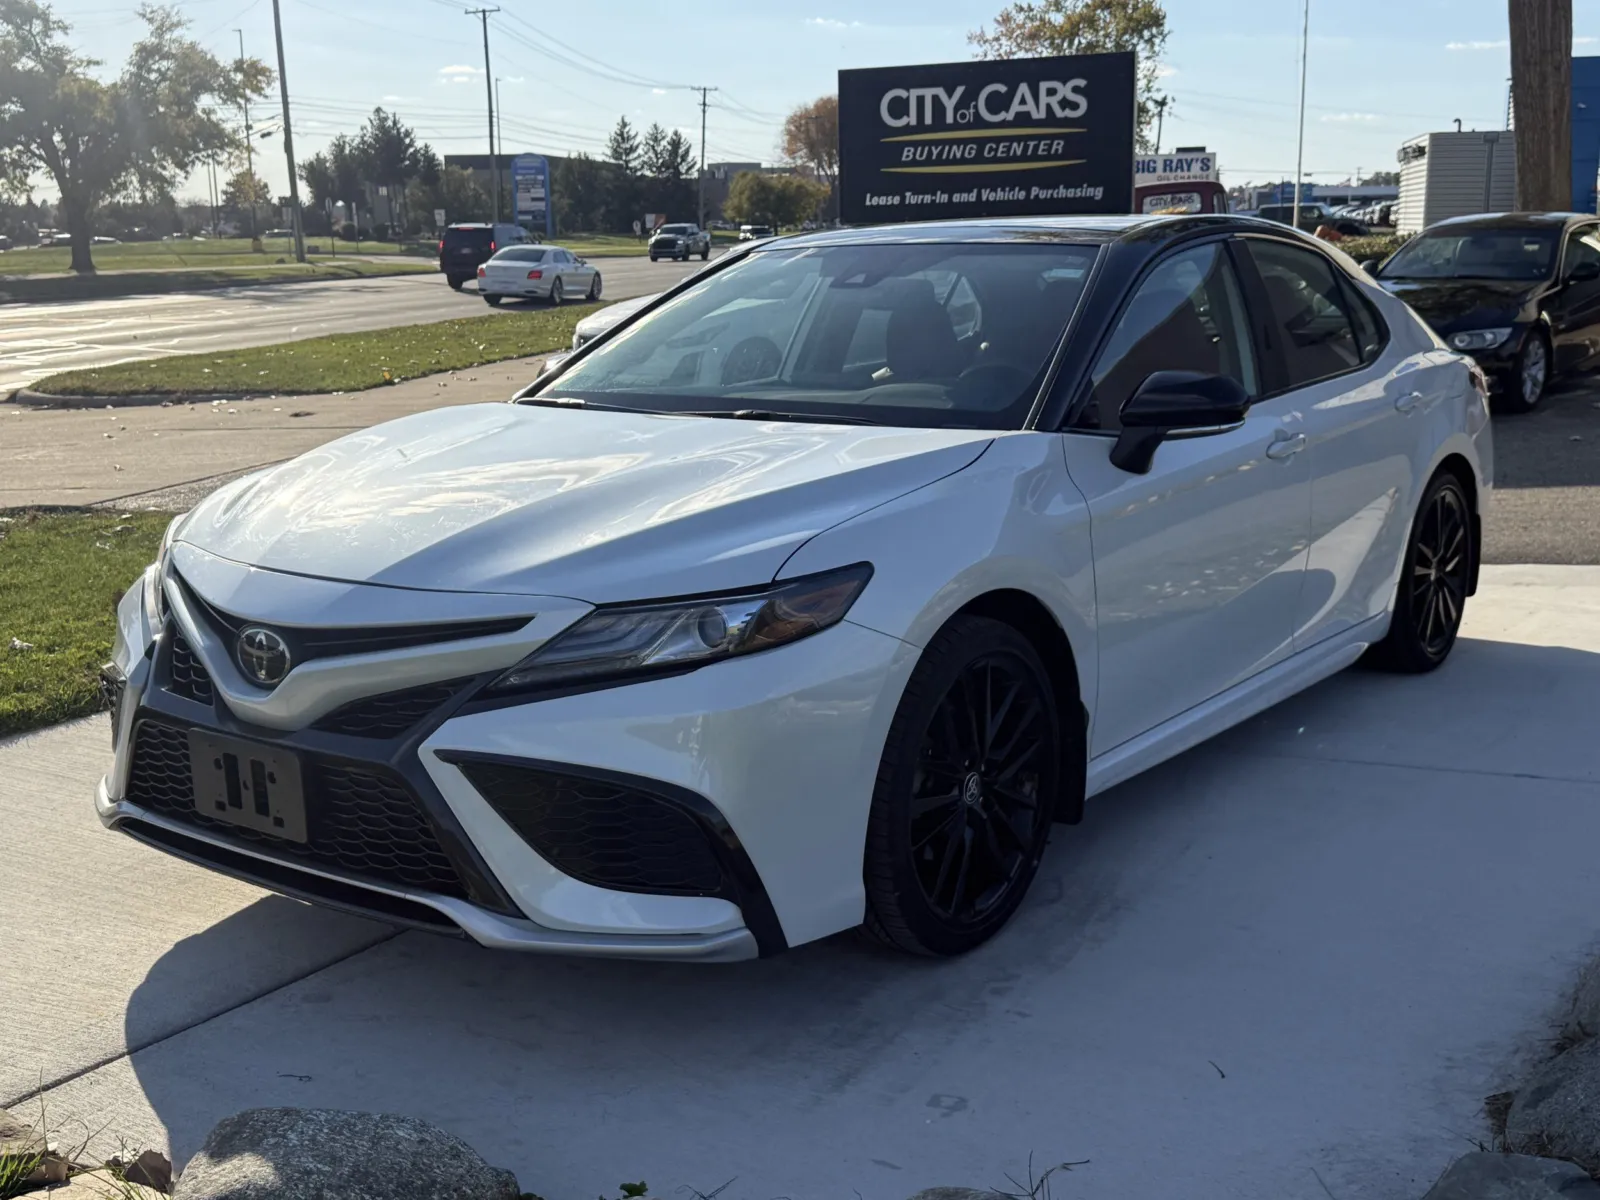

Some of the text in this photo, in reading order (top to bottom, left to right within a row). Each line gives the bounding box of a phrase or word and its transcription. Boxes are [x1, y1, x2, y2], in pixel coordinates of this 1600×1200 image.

[880, 78, 1088, 127] CITY of CARS
[902, 140, 1065, 161] BUYING CENTER
[1163, 158, 1211, 173] RAY'S
[865, 183, 1104, 206] Lease Turn-In and Vehicle Purchasing
